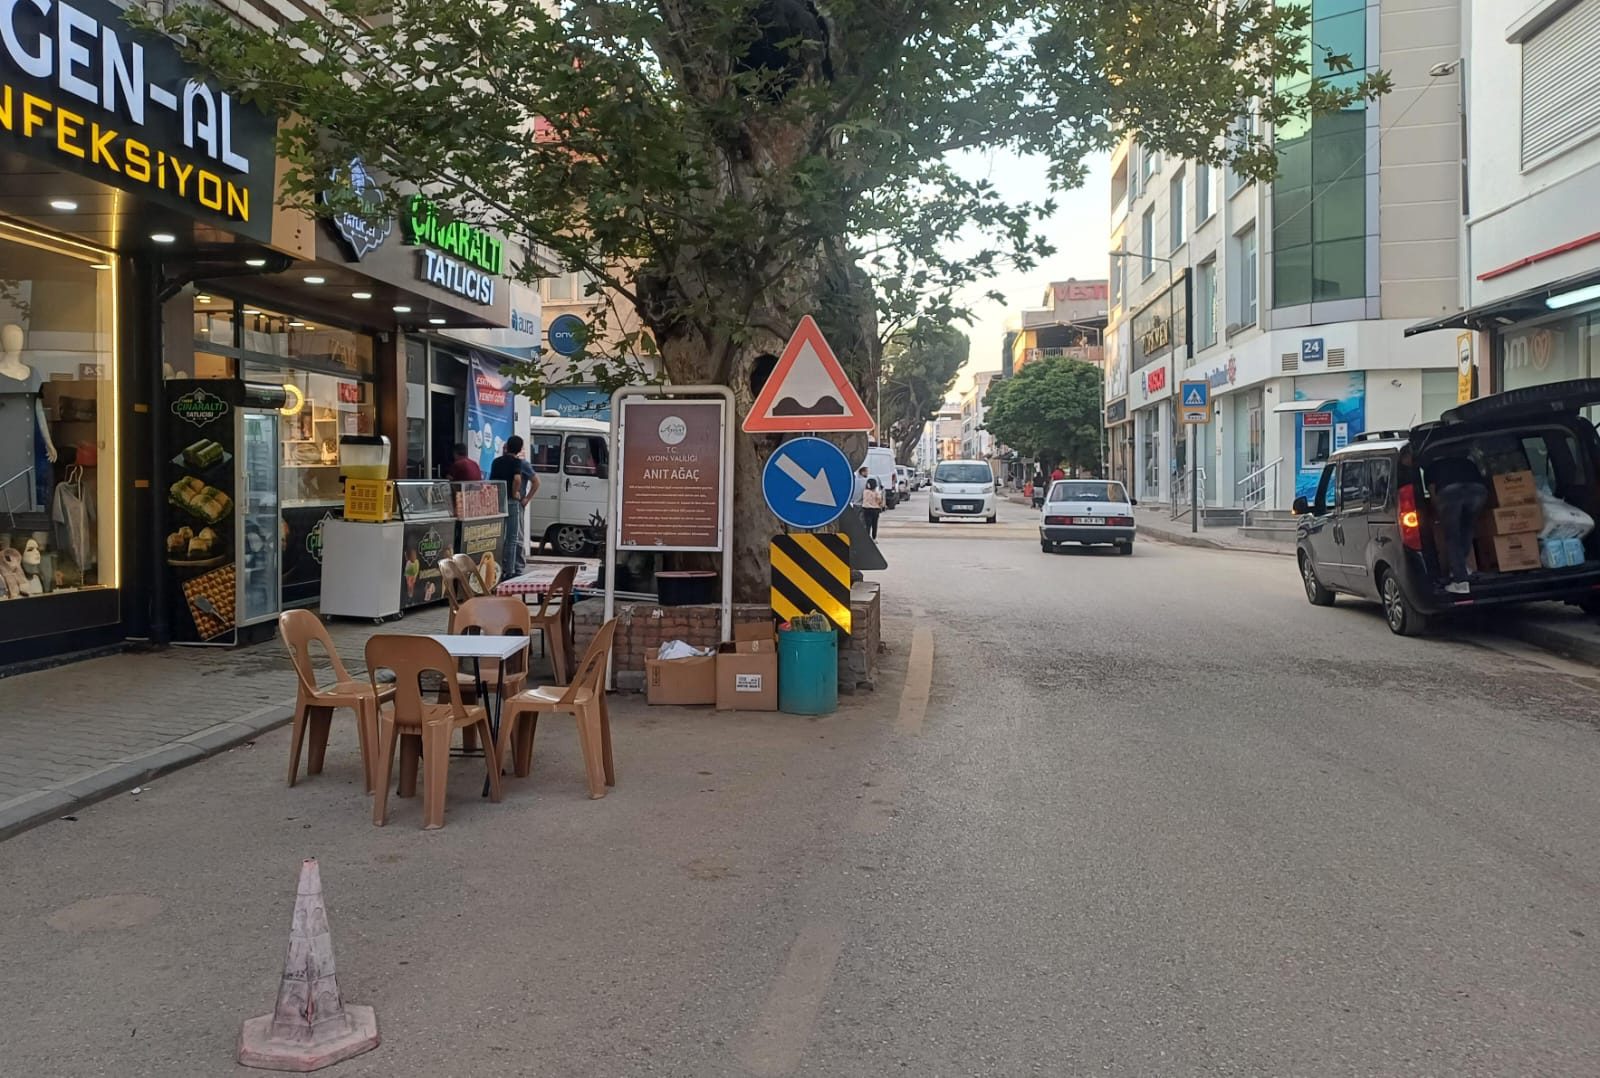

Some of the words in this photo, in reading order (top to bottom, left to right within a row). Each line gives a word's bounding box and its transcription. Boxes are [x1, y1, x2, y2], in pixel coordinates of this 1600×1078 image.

[425, 249, 494, 305] TATLICISI
[1304, 341, 1320, 353] 24
[643, 469, 669, 480] ANIT
[670, 467, 700, 482] AĞAÇ
